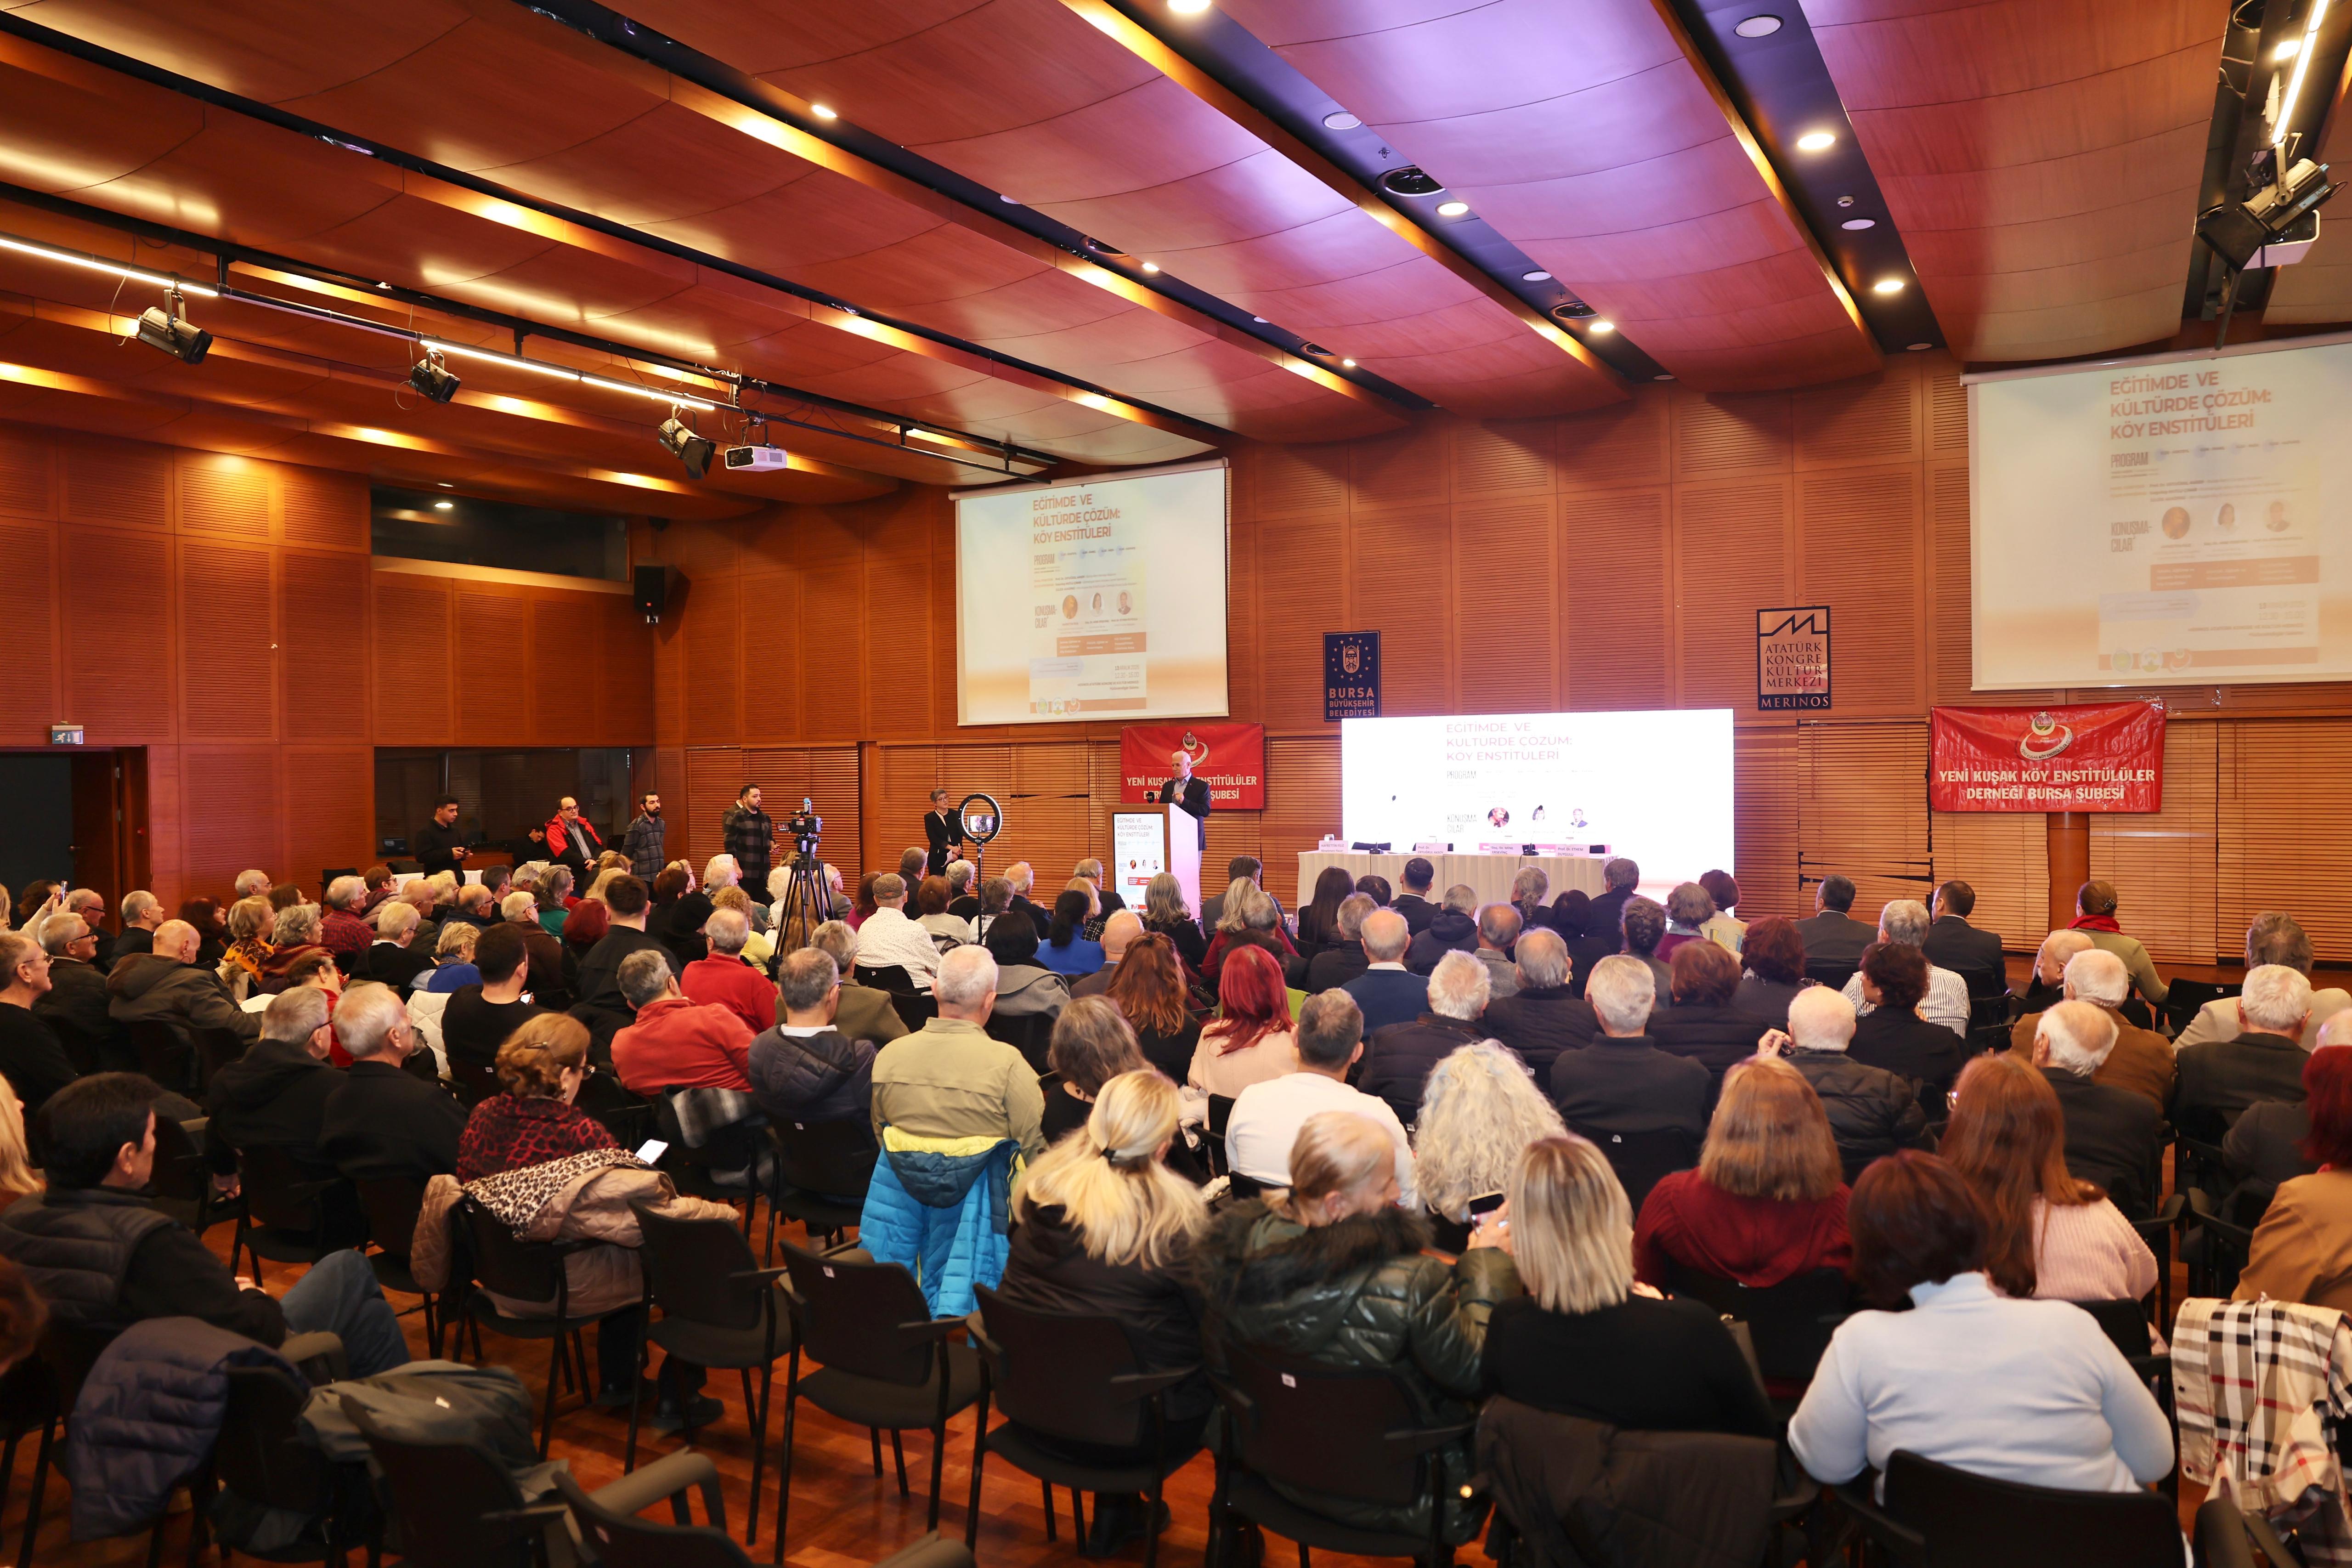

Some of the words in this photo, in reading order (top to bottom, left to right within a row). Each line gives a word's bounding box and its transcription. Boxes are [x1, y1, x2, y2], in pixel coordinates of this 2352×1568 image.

[2110, 373, 2189, 396] EĞİTİMDE
[2196, 370, 2219, 386] VE
[2110, 395, 2199, 417] KÜLTÜRDE
[2202, 387, 2272, 413] ÇÖZÜM:
[2110, 420, 2145, 440] KÖY
[2148, 408, 2254, 436] ENSTİTÜLERİ
[2111, 452, 2148, 468] PROGRAM
[1033, 495, 1076, 511] EĞİTİMDE
[1080, 493, 1092, 505] VE
[1033, 511, 1082, 527] KÜLTÜRDE
[1083, 506, 1120, 526] ÇÖZÜM:
[1034, 530, 1052, 544] KÖY
[1054, 522, 1111, 542] ENSTİTÜLERİ
[1034, 554, 1055, 566] PROGRAM
[1765, 641, 1822, 654] ATATÜRK
[1766, 654, 1821, 665] KONGRE
[1767, 664, 1823, 676] KÜLTÜR
[1766, 675, 1821, 687] MERKEZİ
[1329, 687, 1374, 699] BURSA
[1329, 698, 1374, 709] BÜYÜKŞEHİR
[1762, 696, 1828, 707] MERİNOS
[1329, 708, 1375, 717] BELEDİYESİ
[1514, 722, 1531, 731] VE
[1126, 775, 1145, 786] YENİ
[1447, 770, 1476, 780] PROGRAM
[1939, 768, 1969, 782] YENİ
[1973, 770, 2018, 785] KUŞAK
[2022, 768, 2049, 782] KÖY
[2054, 767, 2155, 782] ENSTİTÜLÜLER
[1210, 788, 1239, 802] ŞUBESİ
[1967, 787, 2024, 800] DERNEĞİ
[2027, 788, 2071, 800] BURSA
[2075, 787, 2125, 802] ŞUBESİ
